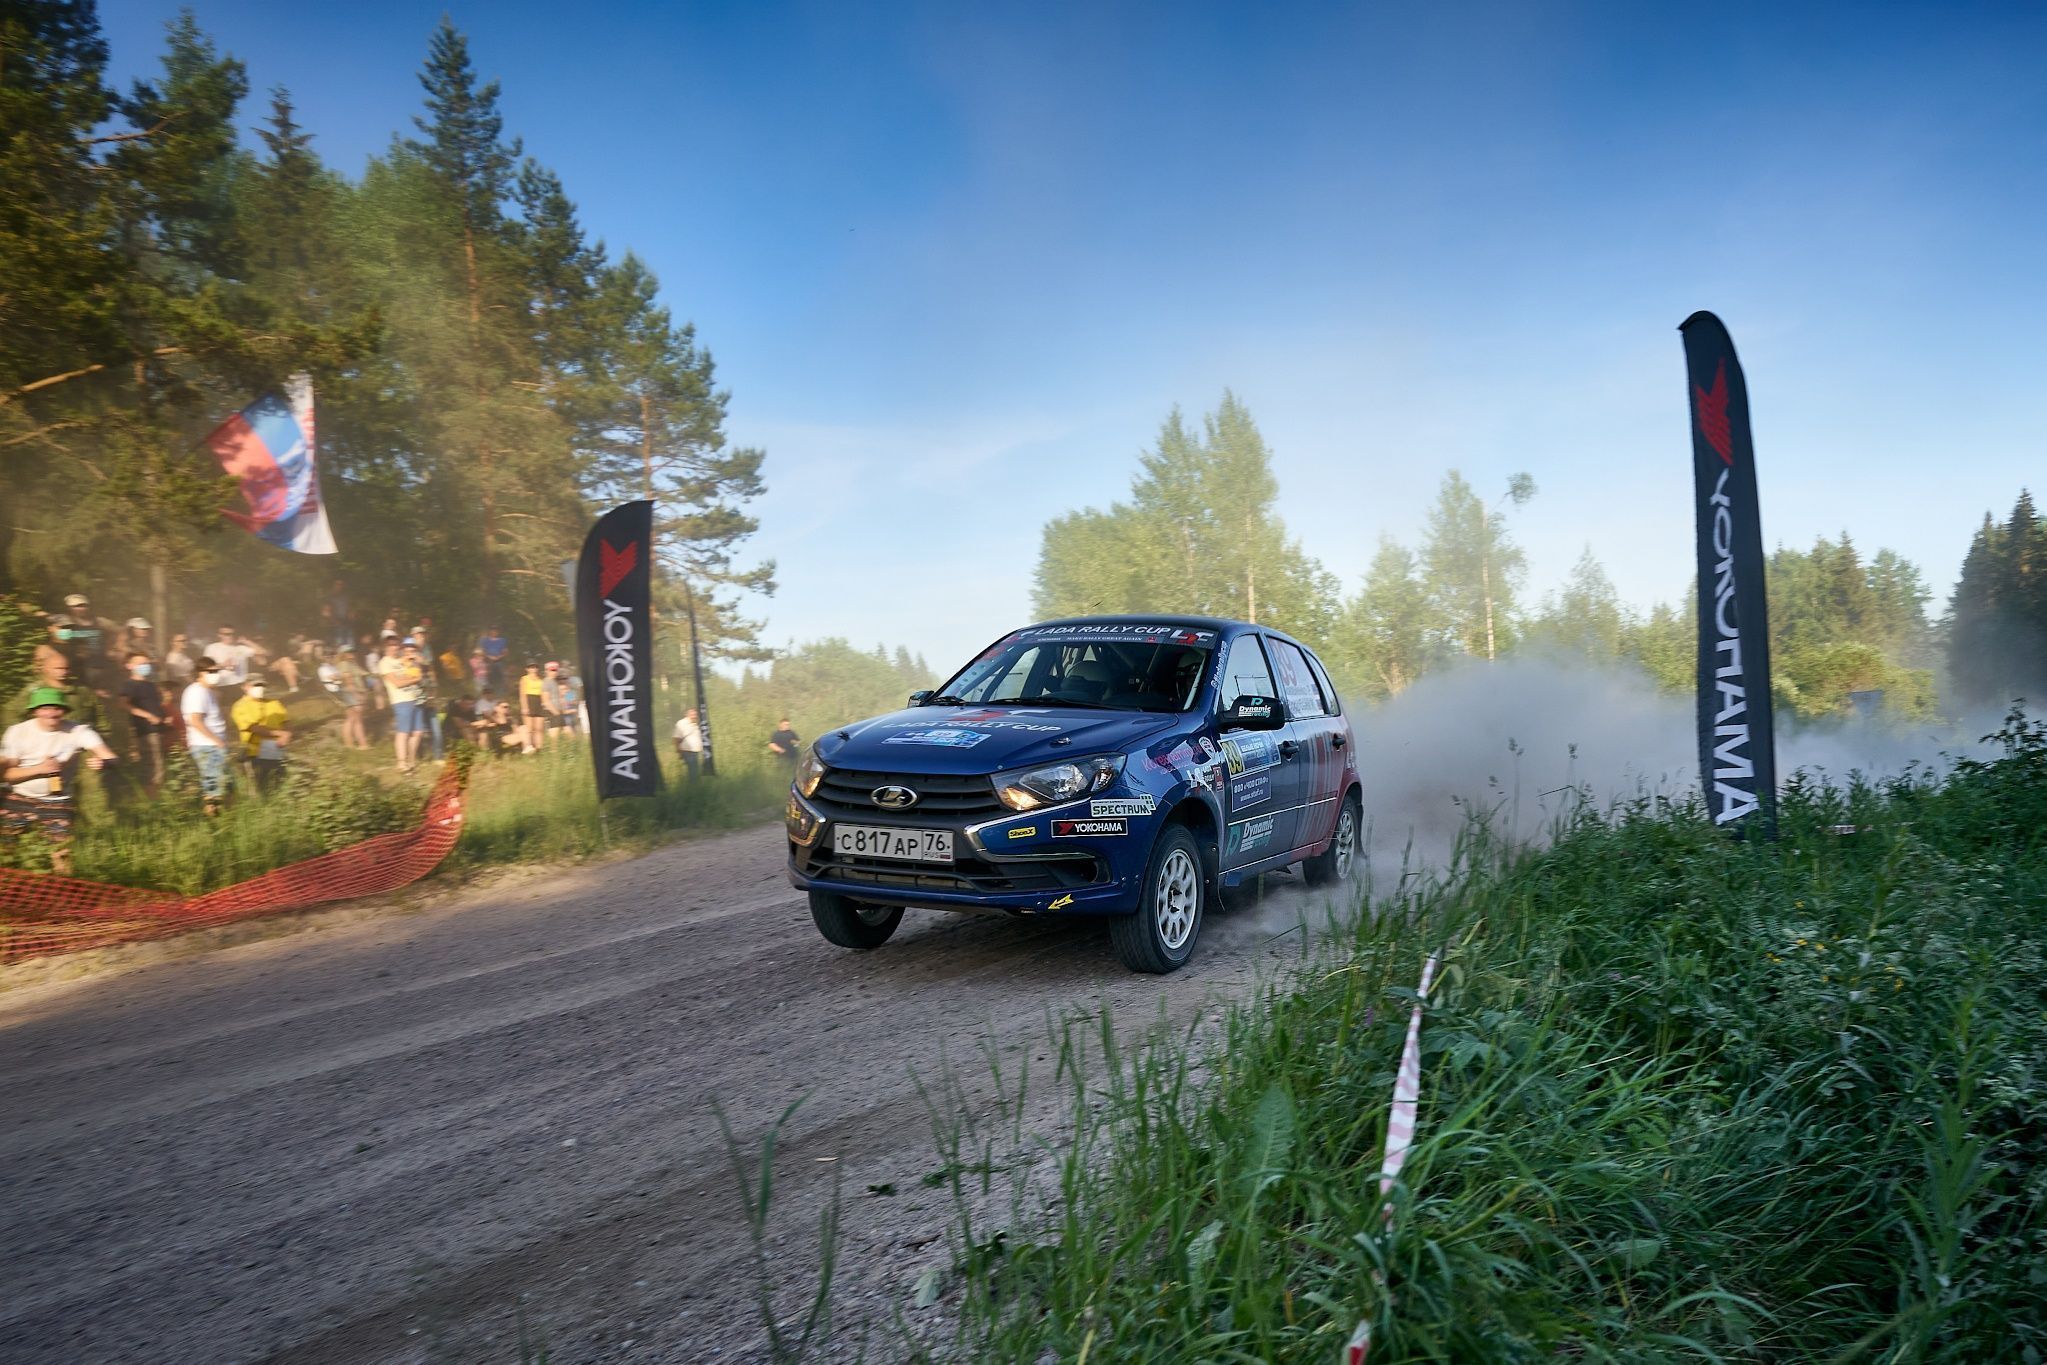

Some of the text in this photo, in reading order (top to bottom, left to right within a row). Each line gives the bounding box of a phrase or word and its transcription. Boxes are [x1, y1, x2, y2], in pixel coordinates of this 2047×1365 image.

[1036, 625, 1171, 635] LADA RALLY CUP
[1710, 467, 1759, 825] YOKOHAMA
[1240, 705, 1271, 713] Dynamic
[1012, 724, 1062, 732] CUP
[1221, 740, 1243, 774] 39
[1092, 804, 1150, 815] SPECTRUM
[1075, 822, 1122, 833] YOKOHAMA
[1243, 815, 1274, 838] Dynamic
[925, 833, 946, 851] 76
